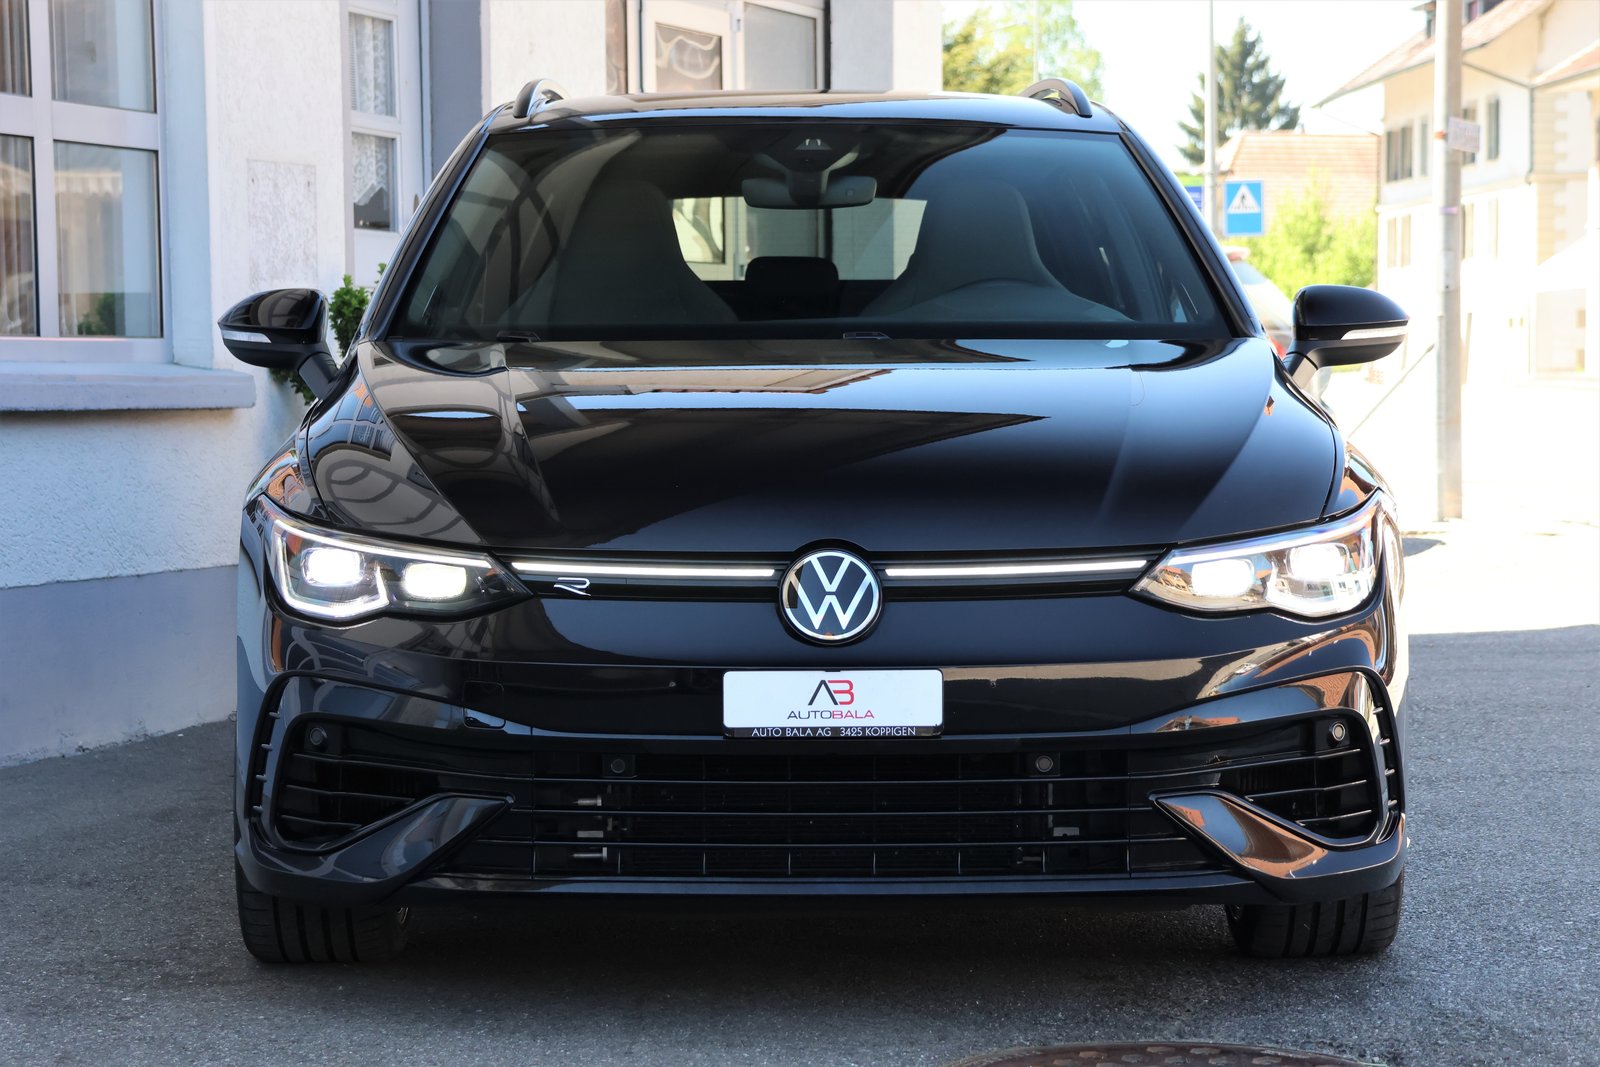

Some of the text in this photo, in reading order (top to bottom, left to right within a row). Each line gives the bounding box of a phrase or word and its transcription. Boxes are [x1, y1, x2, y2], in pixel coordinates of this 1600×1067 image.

[553, 577, 591, 596] R
[787, 555, 874, 631] VW
[807, 679, 855, 706] AB
[787, 709, 875, 720] AUTOBALA
[751, 726, 916, 737] AUTO BALA AG 3425 KOPPIGEN
